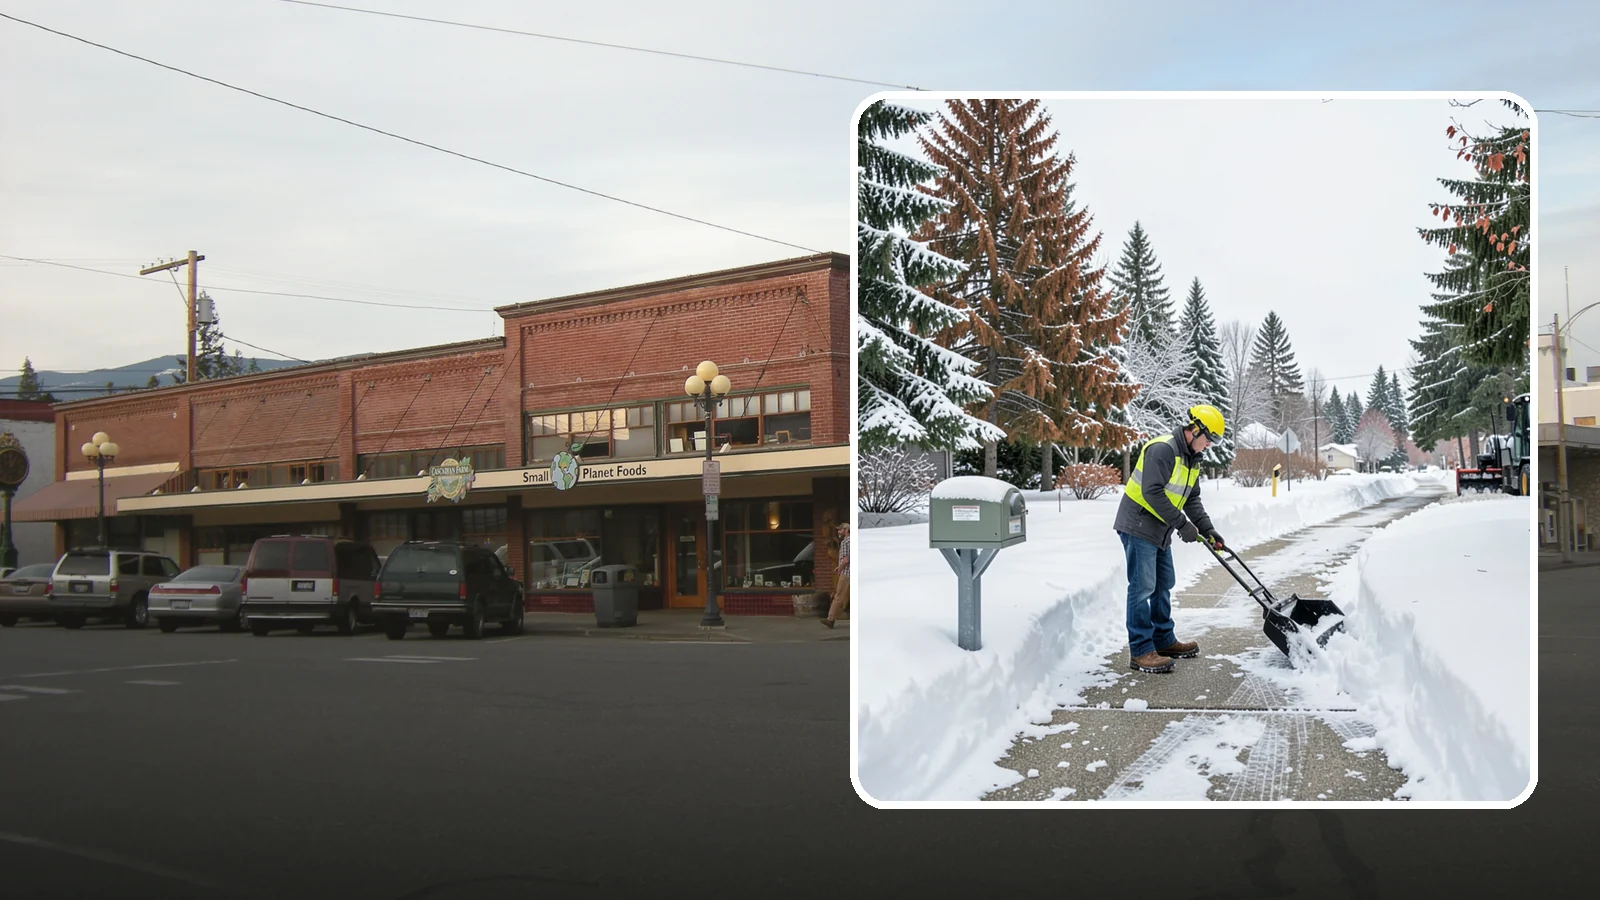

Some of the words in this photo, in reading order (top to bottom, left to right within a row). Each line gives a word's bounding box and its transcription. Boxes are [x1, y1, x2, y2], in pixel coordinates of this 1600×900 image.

[523, 471, 549, 483] Small
[583, 467, 614, 479] Planet
[617, 464, 647, 477] Foods
